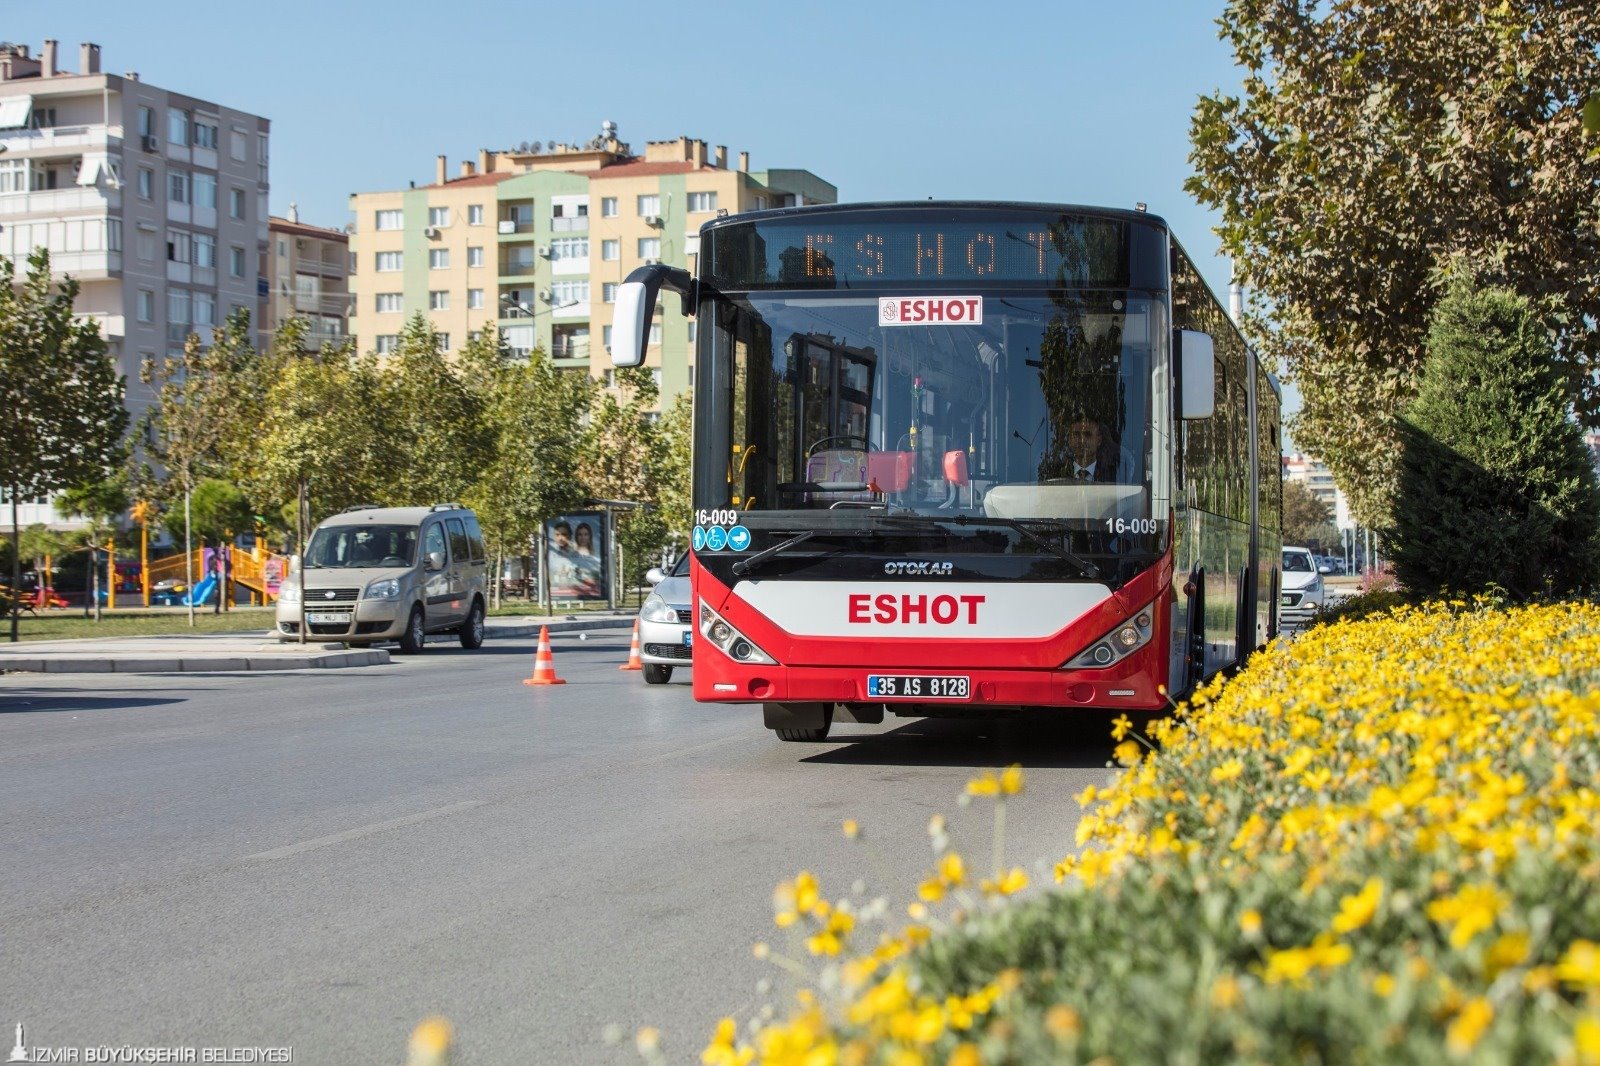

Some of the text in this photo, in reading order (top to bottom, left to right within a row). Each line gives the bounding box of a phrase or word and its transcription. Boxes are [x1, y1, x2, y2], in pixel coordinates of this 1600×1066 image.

[900, 299, 979, 322] ESHOT
[694, 509, 738, 526] 16-009
[1105, 517, 1157, 535] 16-009
[884, 561, 954, 575] OTOKAR
[848, 594, 986, 625] ESHOT
[878, 677, 967, 696] 35 AS 8128
